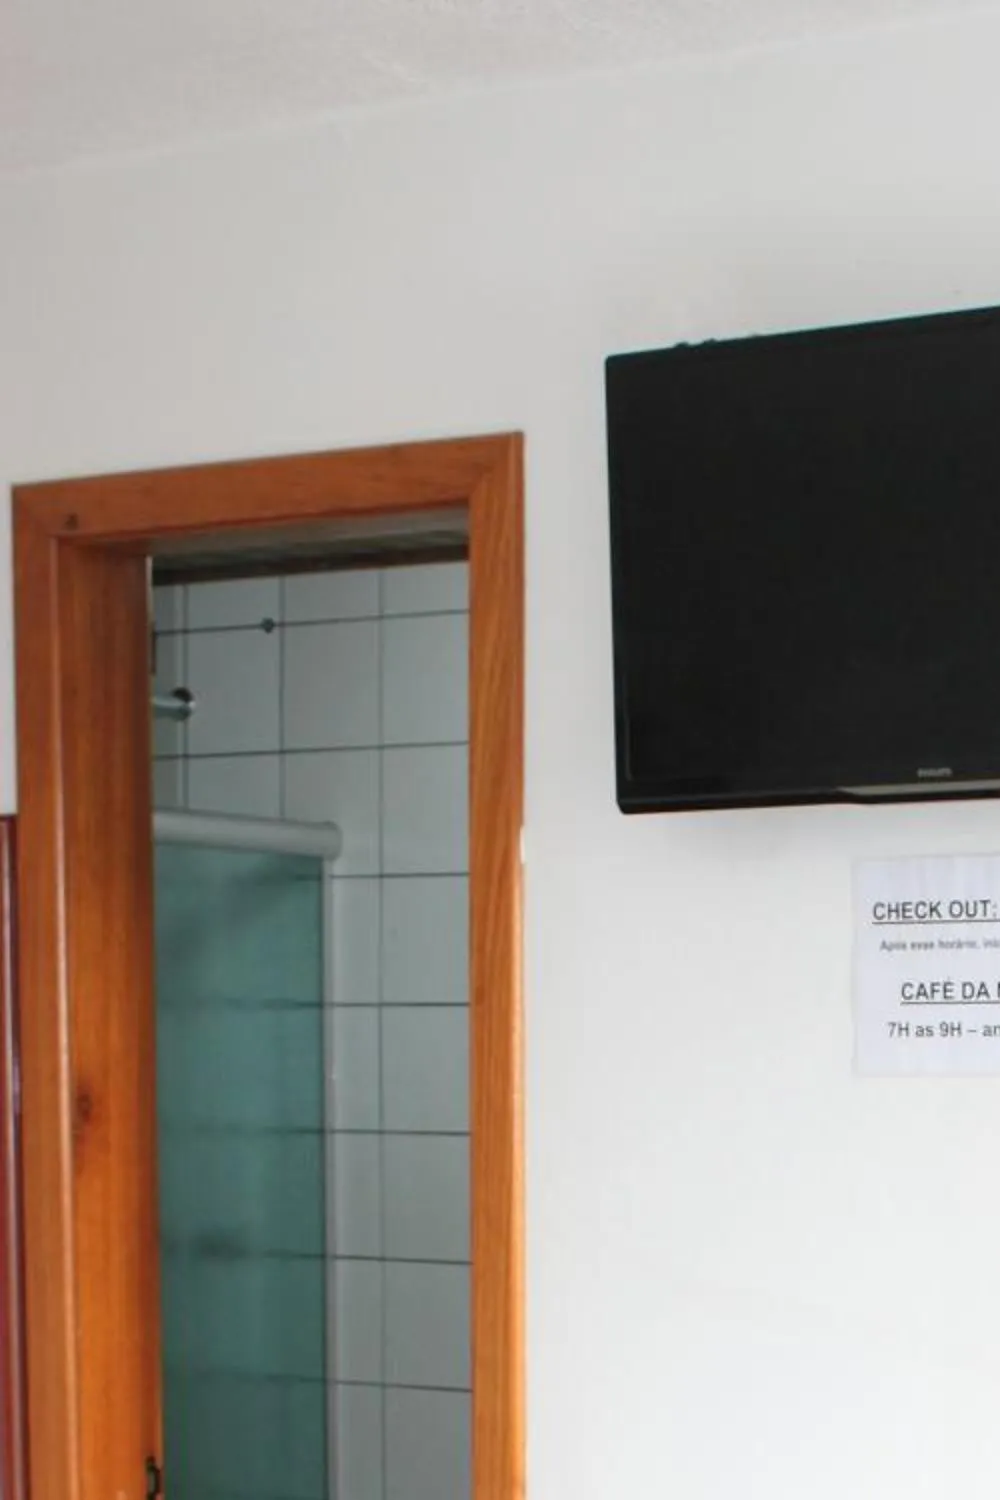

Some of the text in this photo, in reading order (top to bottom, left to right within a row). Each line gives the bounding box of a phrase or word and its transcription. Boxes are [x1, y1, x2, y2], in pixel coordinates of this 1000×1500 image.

[873, 900, 942, 920] CHECK
[949, 898, 998, 919] OUT:
[900, 977, 955, 1000] CAFÉ
[961, 981, 991, 1000] DA
[887, 1021, 910, 1037] 7H
[939, 1021, 962, 1037] 9H
